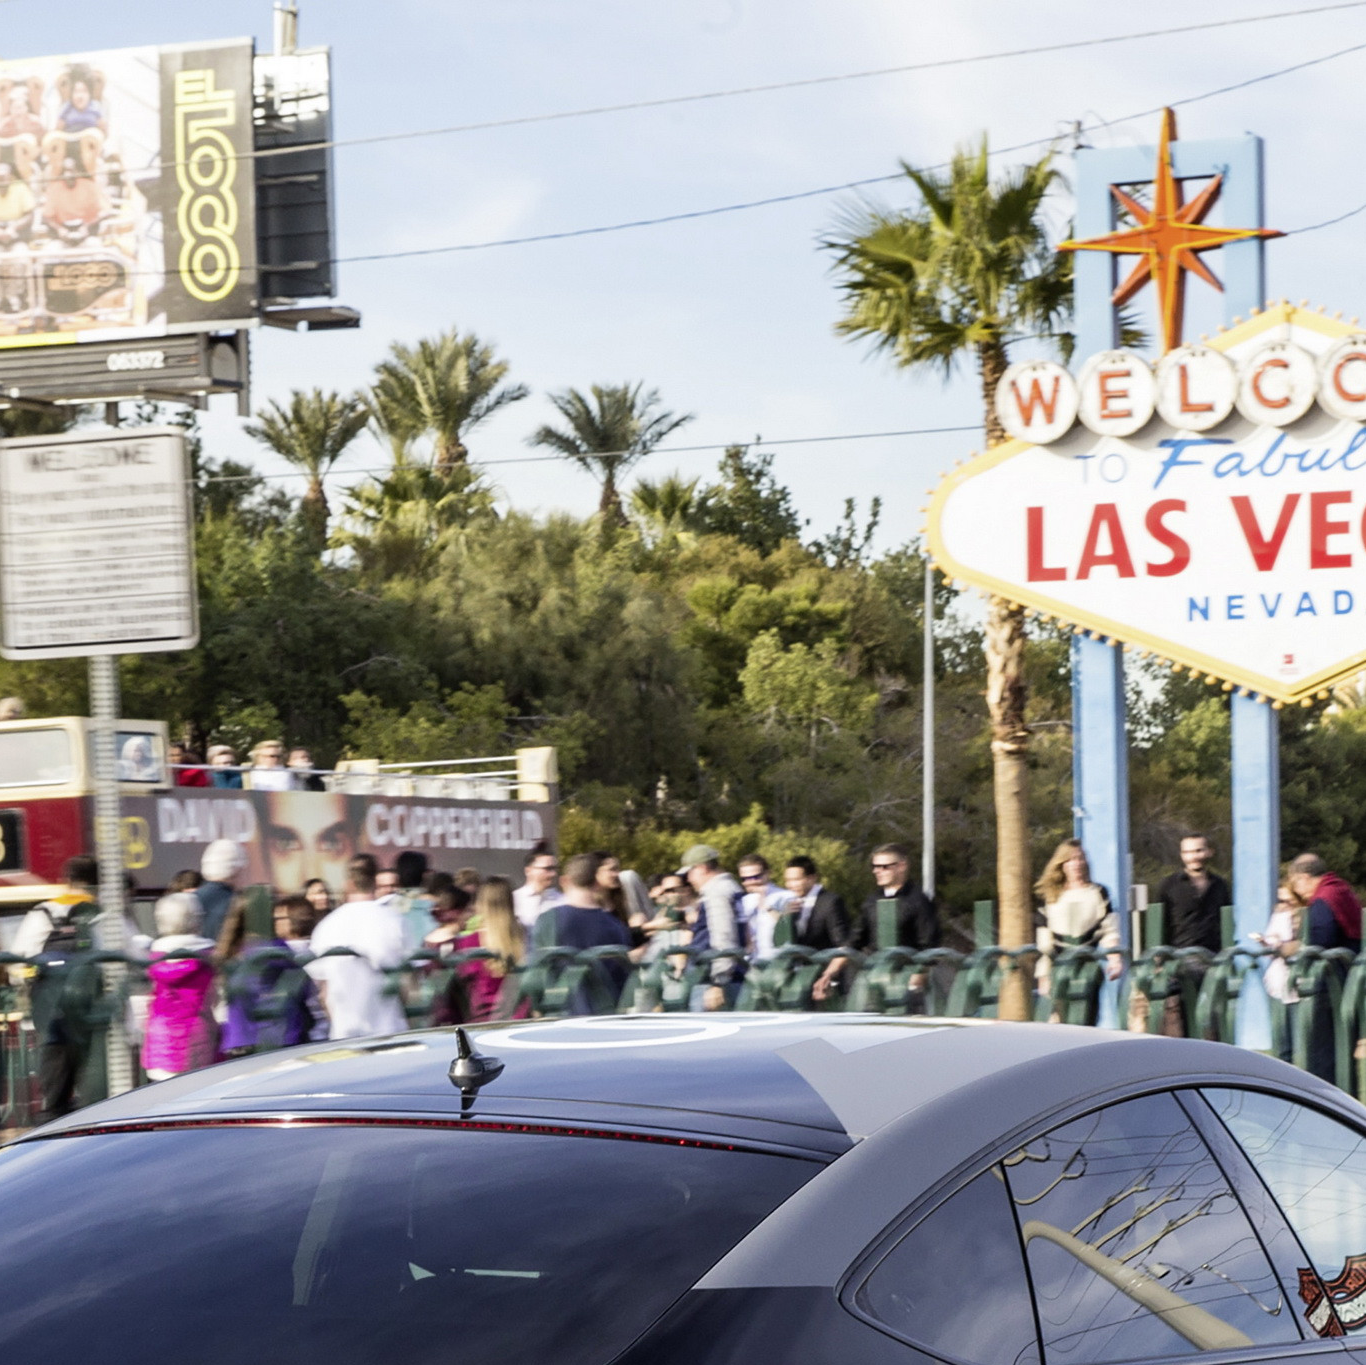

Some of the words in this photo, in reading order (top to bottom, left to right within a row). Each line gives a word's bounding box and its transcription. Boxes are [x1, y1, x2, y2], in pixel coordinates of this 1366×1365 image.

[1076, 454, 1127, 485] TO
[1026, 499, 1190, 582] LAS
[157, 797, 255, 843] DAVID
[366, 803, 544, 850] COPPERFIELD
